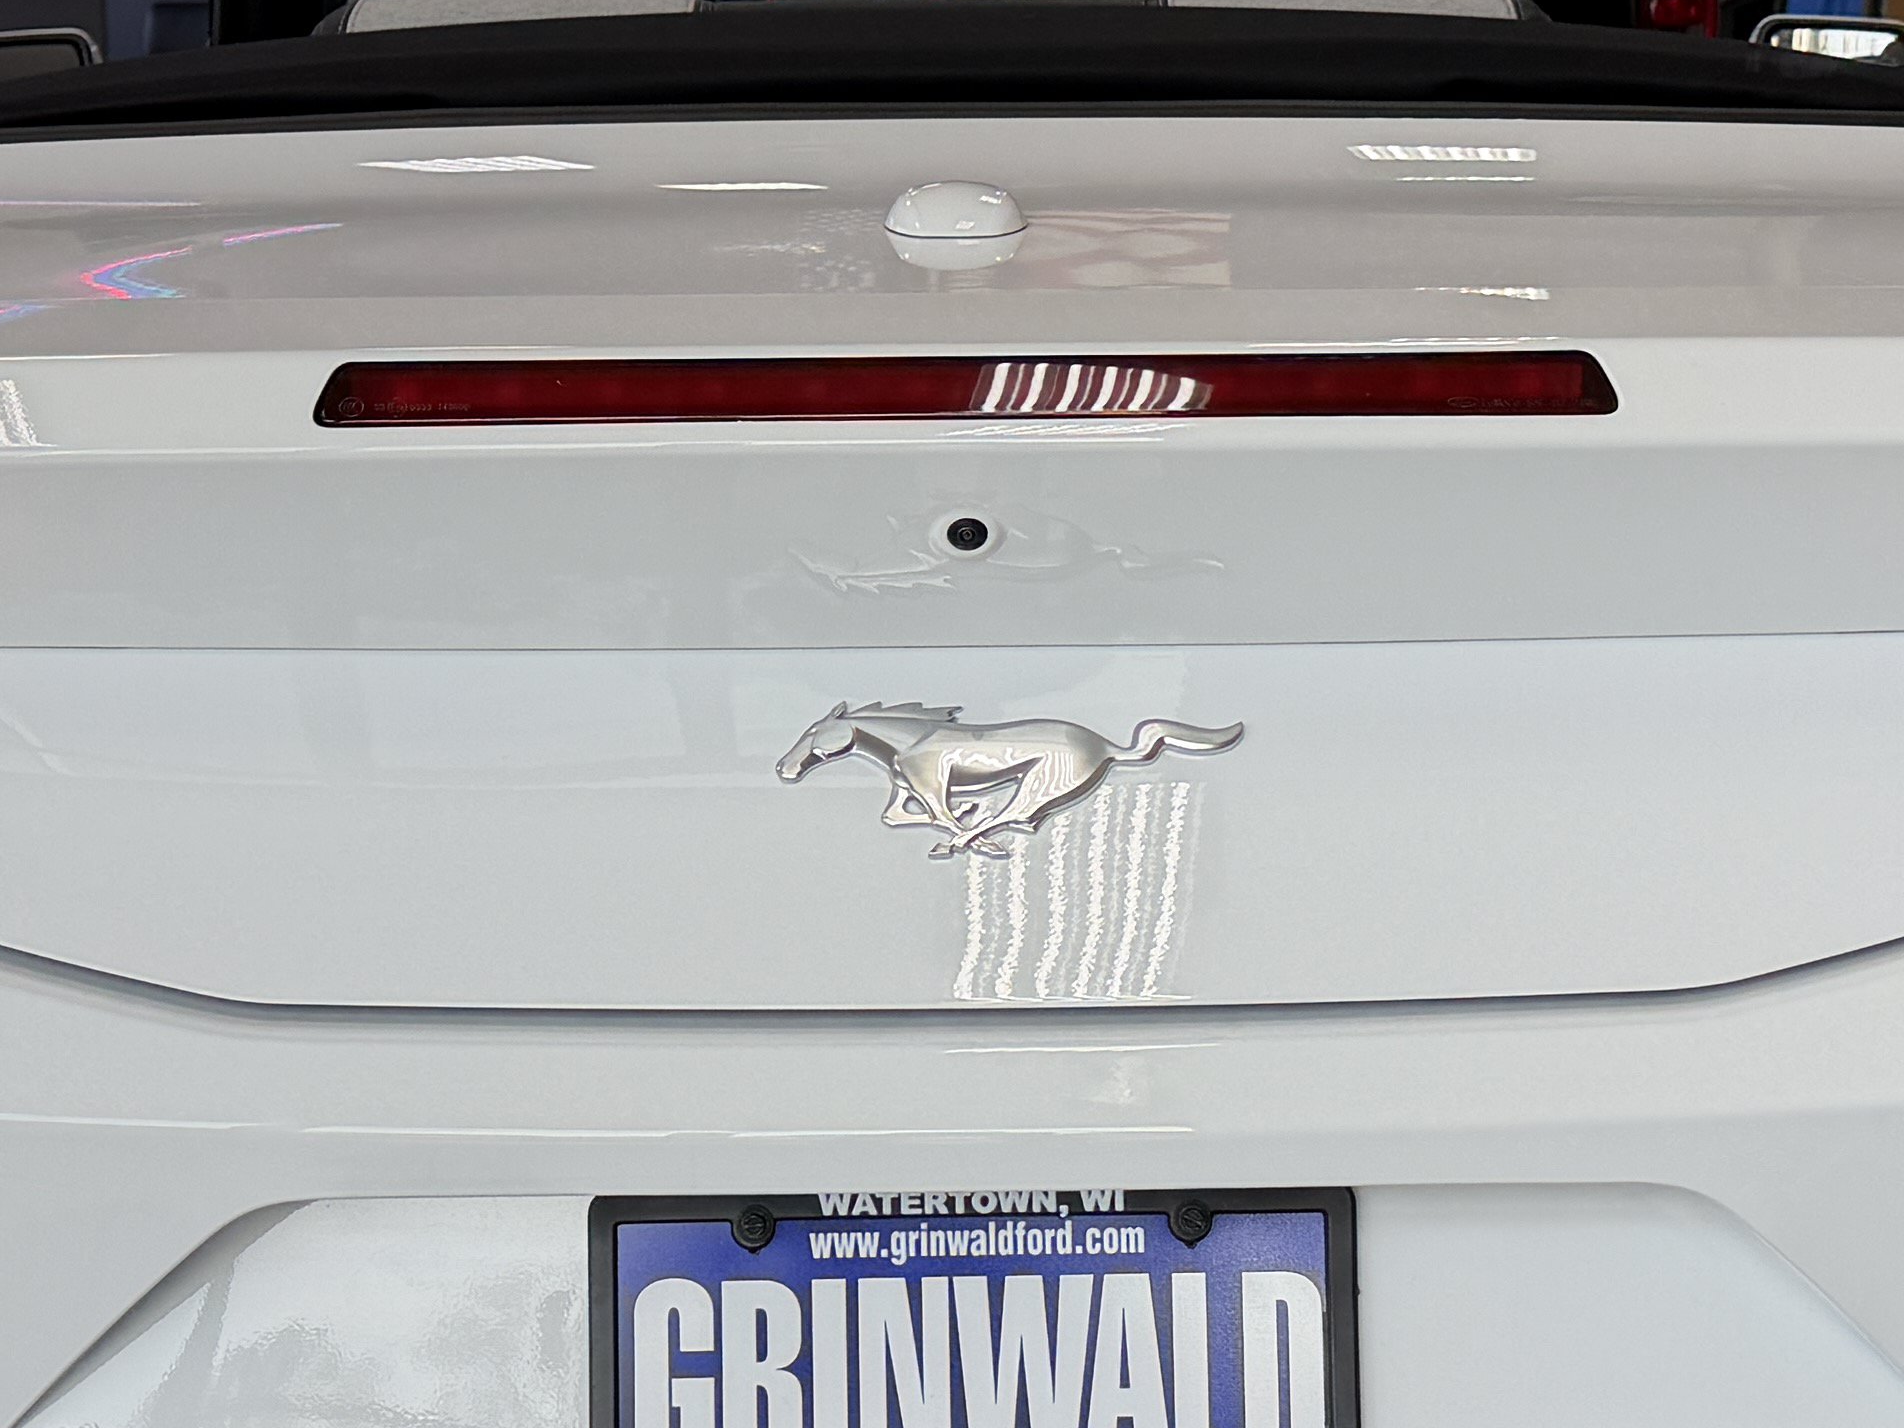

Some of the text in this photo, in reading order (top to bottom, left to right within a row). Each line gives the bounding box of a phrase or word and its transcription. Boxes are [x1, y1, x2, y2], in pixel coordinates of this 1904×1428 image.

[817, 1189, 1125, 1218] WATERTOWN, WI
[808, 1220, 1145, 1266] www.grinwaldford.com
